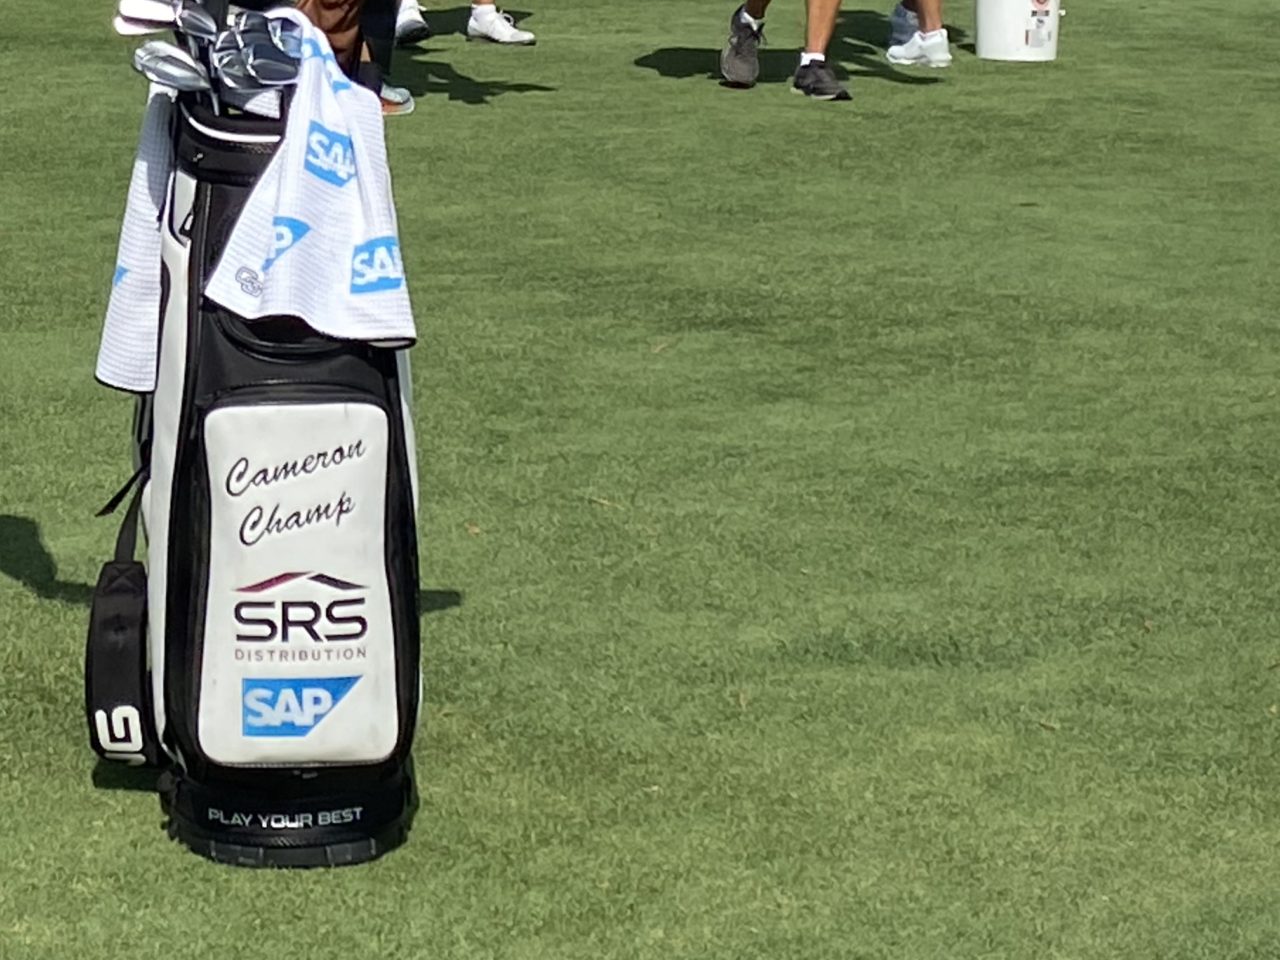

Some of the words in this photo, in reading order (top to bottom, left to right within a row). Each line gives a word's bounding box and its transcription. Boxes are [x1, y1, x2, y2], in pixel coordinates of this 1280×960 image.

[226, 439, 366, 497] Cameron
[239, 491, 355, 546] Champ
[234, 597, 368, 642] SRS
[234, 646, 367, 662] DISTRIBUTION
[244, 687, 332, 727] SAP
[208, 808, 252, 827] PLAY
[257, 813, 313, 829] YOUR
[318, 807, 363, 825] BEST
